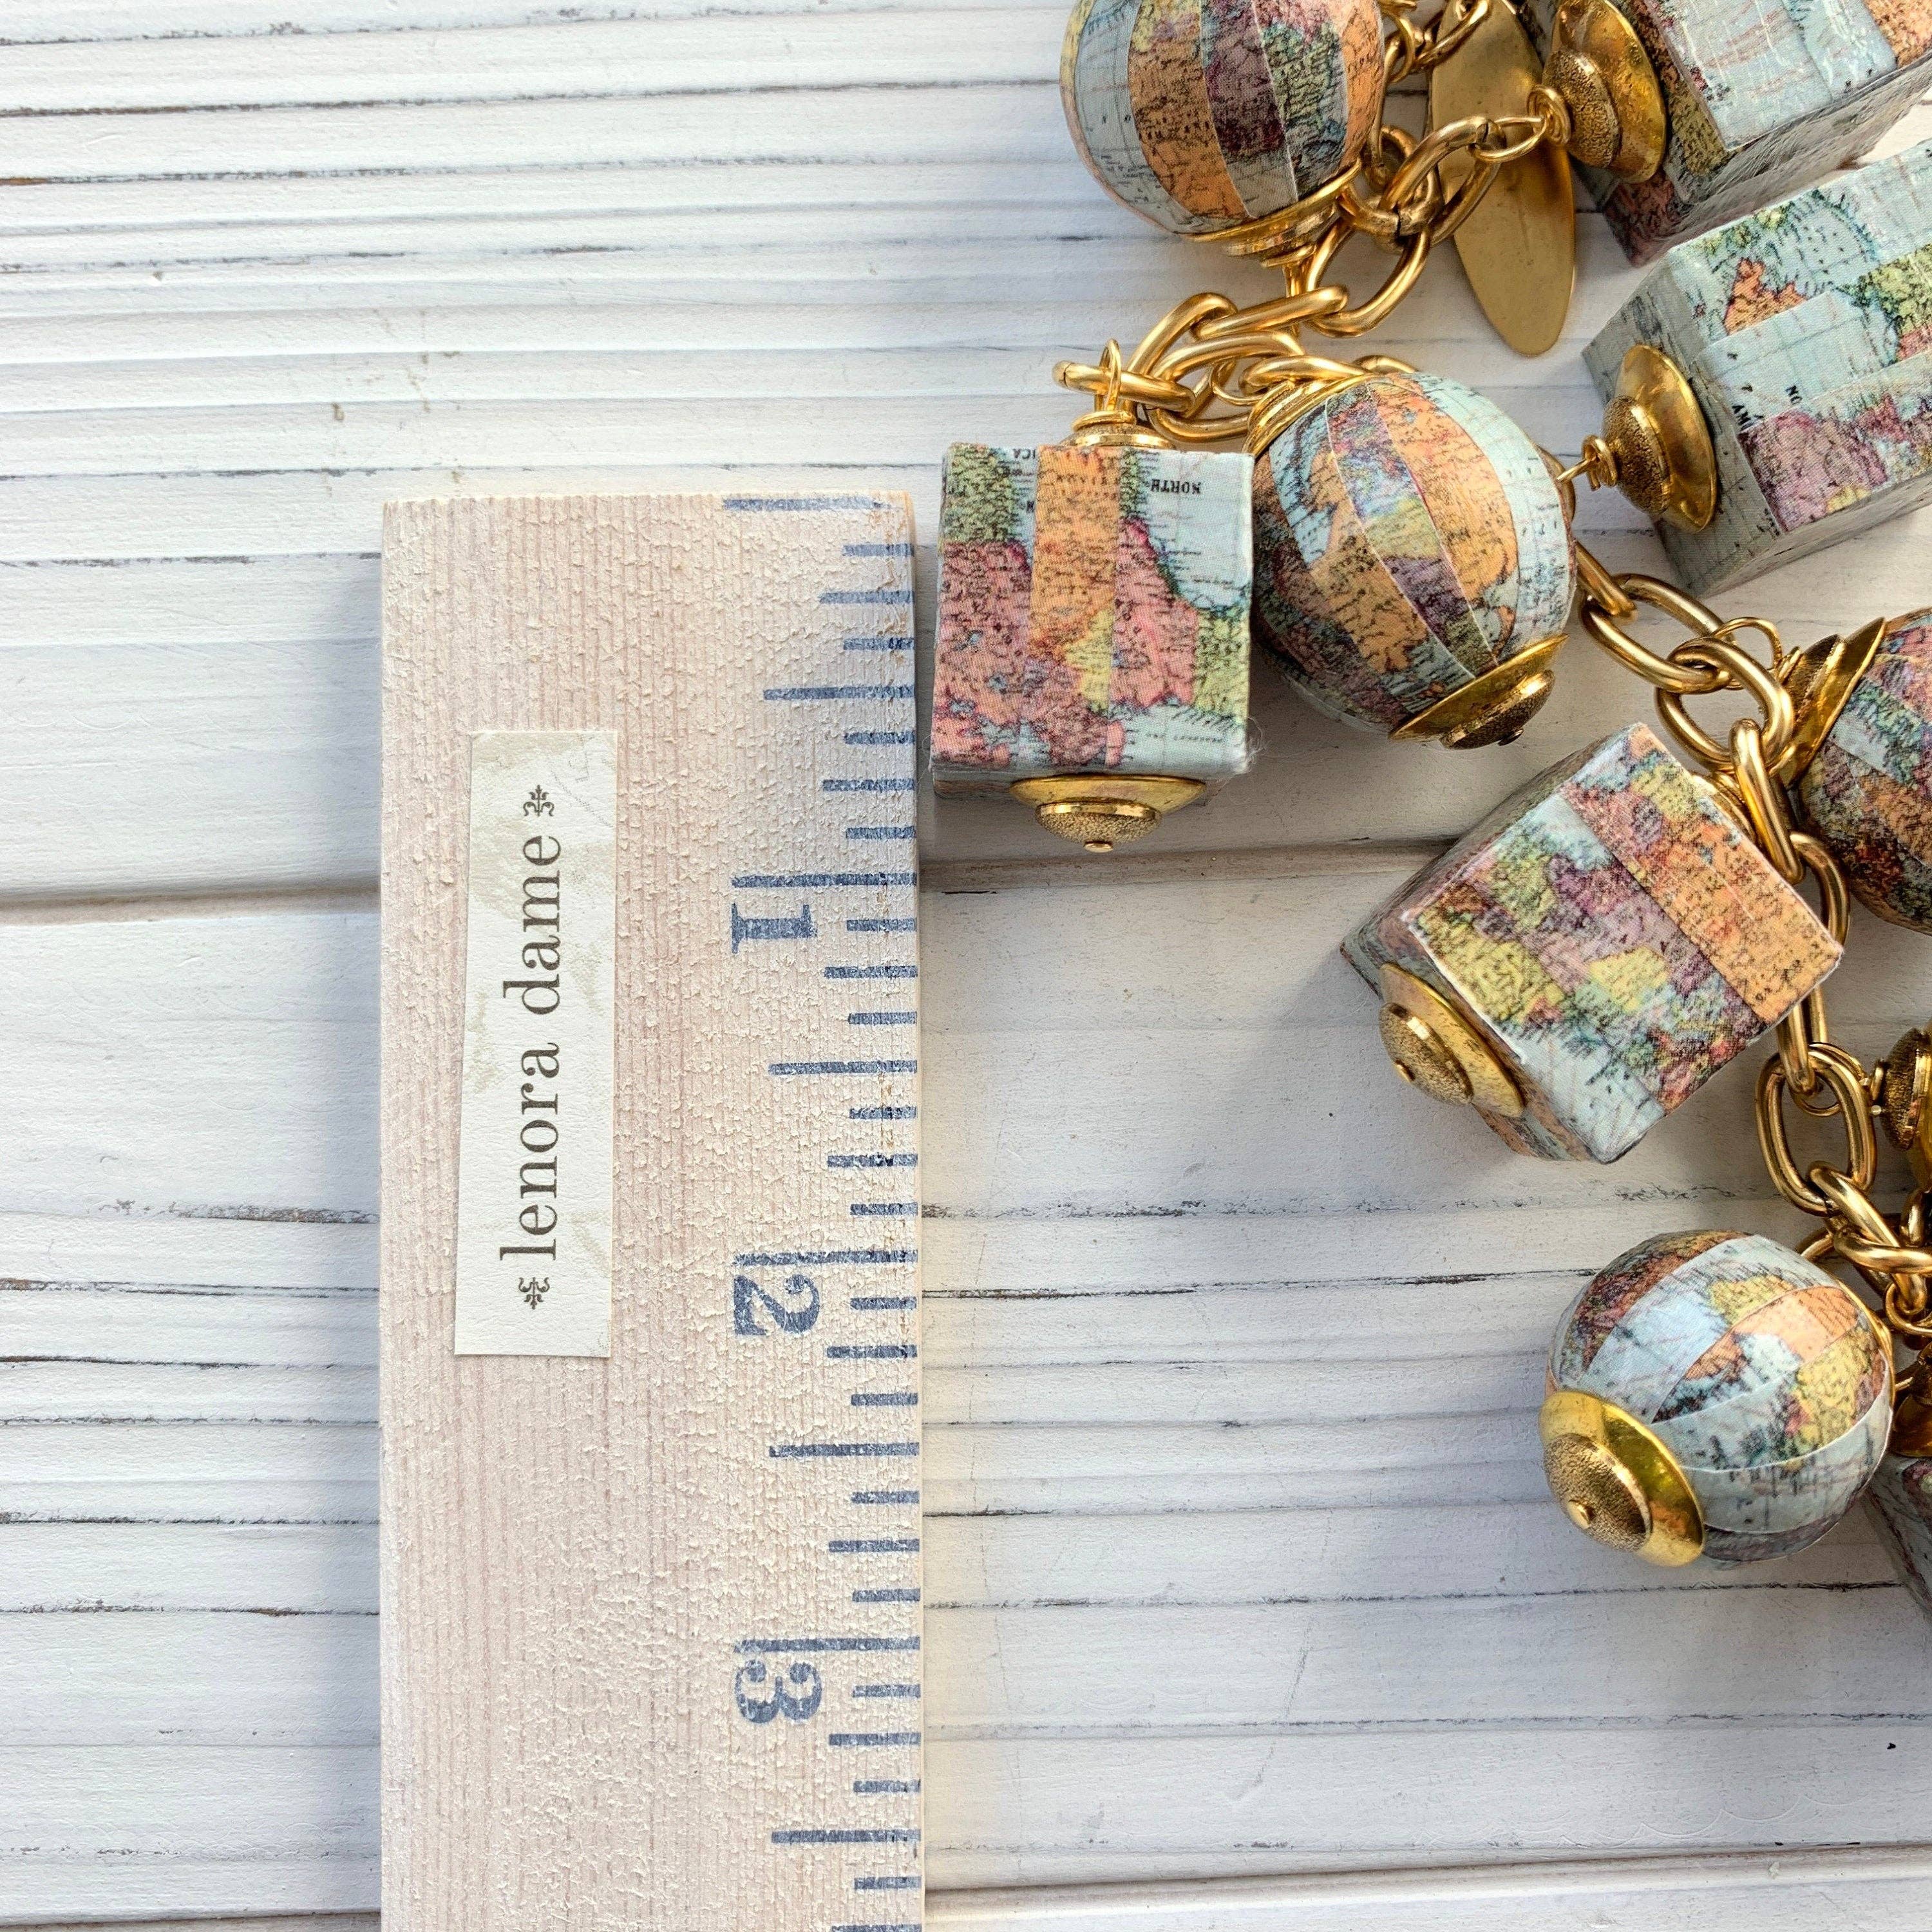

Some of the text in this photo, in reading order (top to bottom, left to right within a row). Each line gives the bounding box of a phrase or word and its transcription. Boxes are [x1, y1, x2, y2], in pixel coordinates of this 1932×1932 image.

[1150, 478, 1202, 496] NORTH
[731, 903, 818, 954] 1
[499, 833, 562, 1262] lenora dame
[733, 1273, 820, 1338] 2
[734, 1659, 822, 1723] 3
